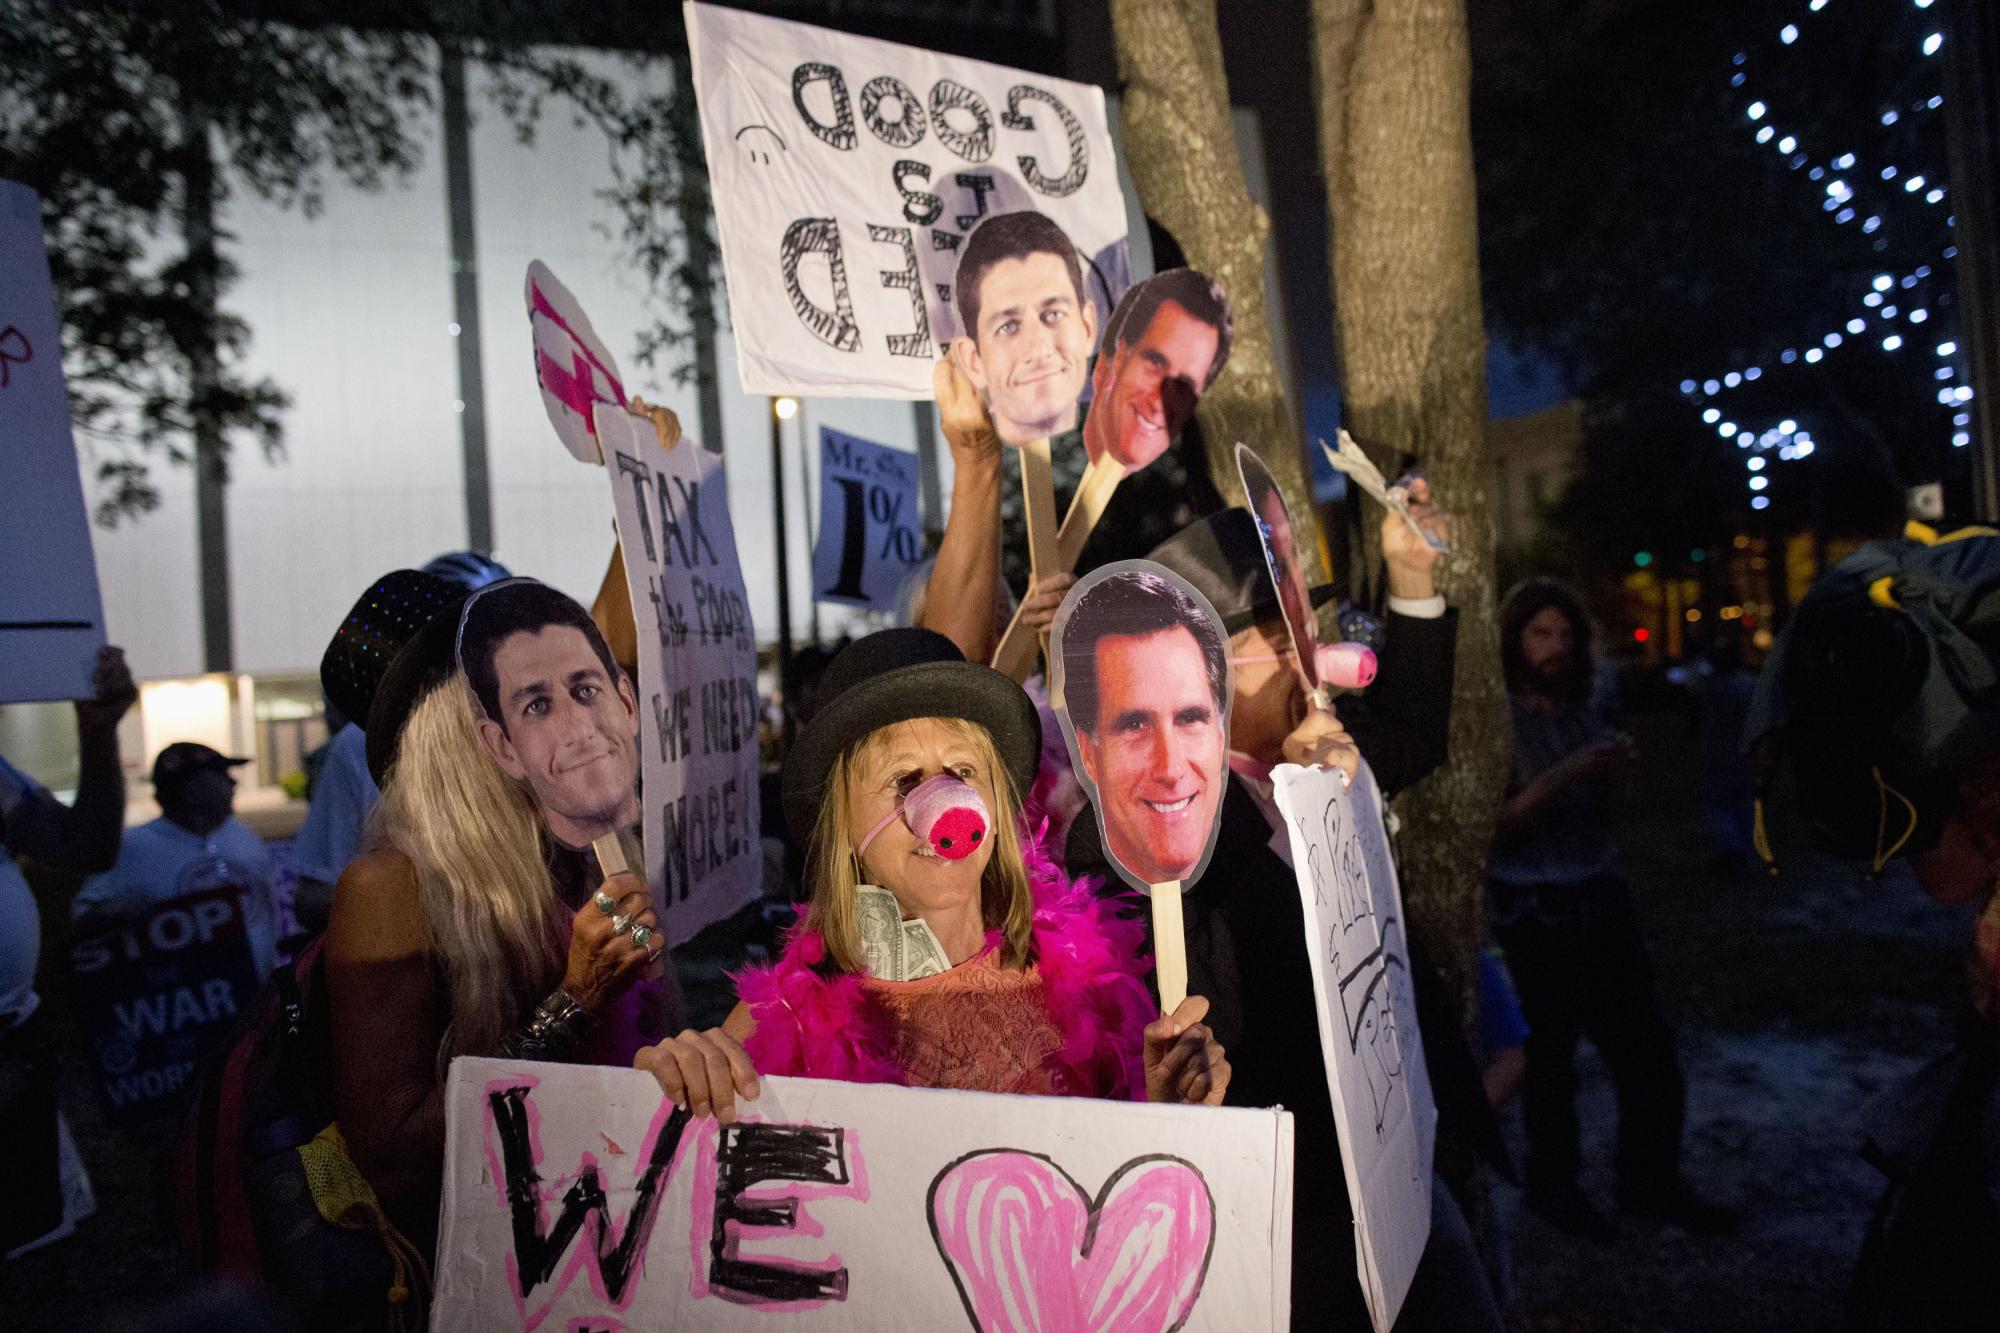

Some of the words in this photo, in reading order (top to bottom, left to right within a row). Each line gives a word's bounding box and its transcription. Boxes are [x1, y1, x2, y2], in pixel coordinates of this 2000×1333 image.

[792, 61, 1090, 198] GOOD
[616, 450, 718, 568] TAX
[823, 474, 916, 601] 1%
[649, 574, 688, 648] the
[652, 687, 692, 764] WE
[701, 677, 756, 756] NEED
[662, 770, 749, 909] MORE!
[71, 899, 233, 972] STOP
[113, 979, 238, 1039] WAR
[484, 1076, 868, 1312] WE
